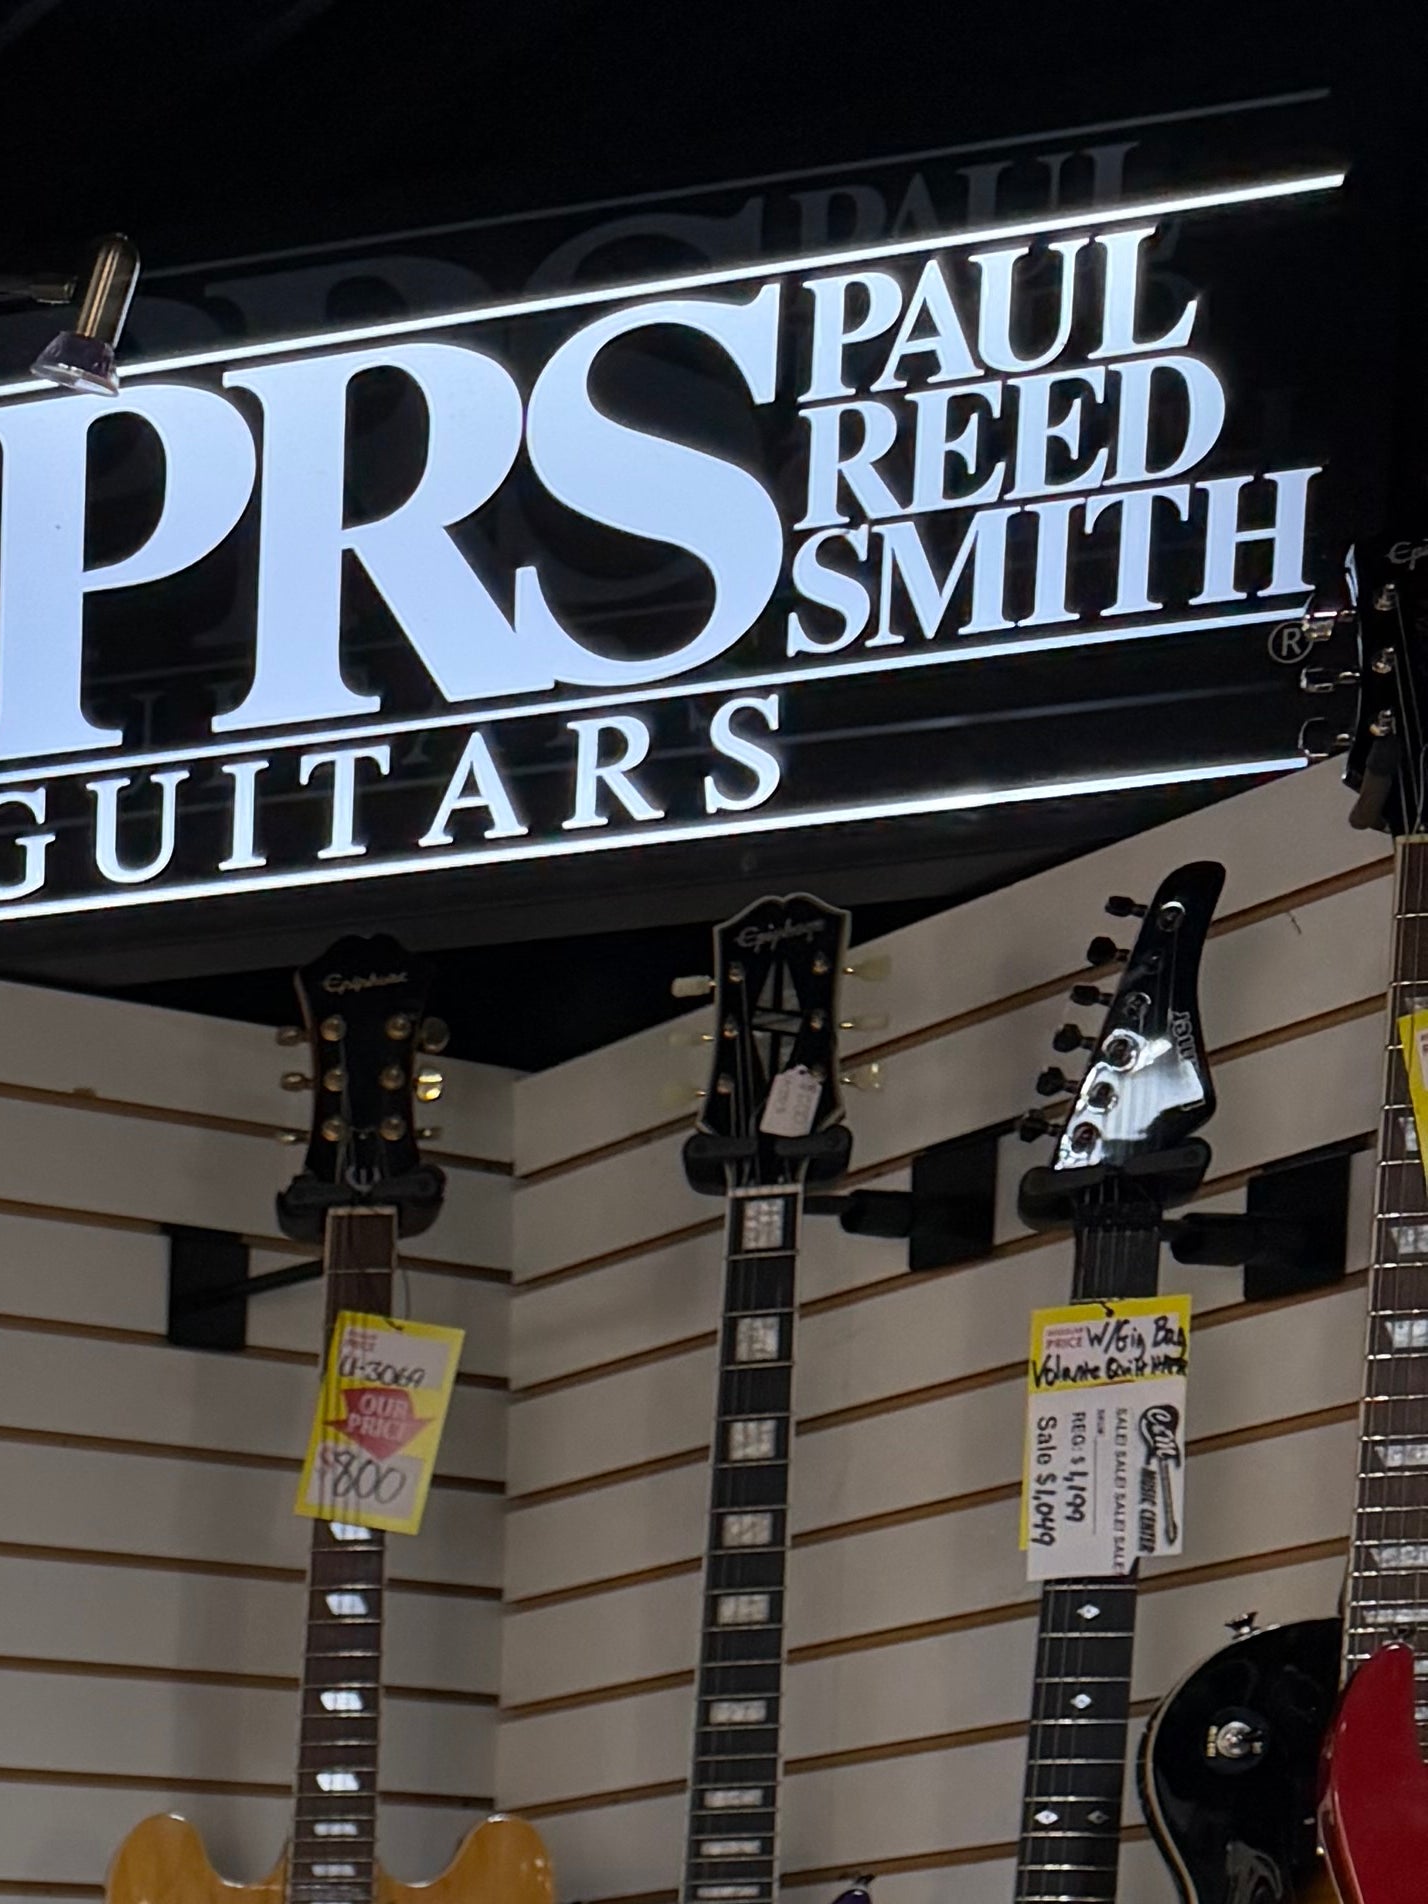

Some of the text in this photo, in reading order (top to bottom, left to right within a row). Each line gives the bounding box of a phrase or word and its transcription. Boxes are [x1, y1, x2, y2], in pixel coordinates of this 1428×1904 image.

[795, 227, 1198, 402] PAUL
[793, 354, 1227, 532] REED
[787, 466, 1324, 660] SMITH
[358, 1392, 408, 1419] OUR
[1036, 1415, 1058, 1466] Sale
